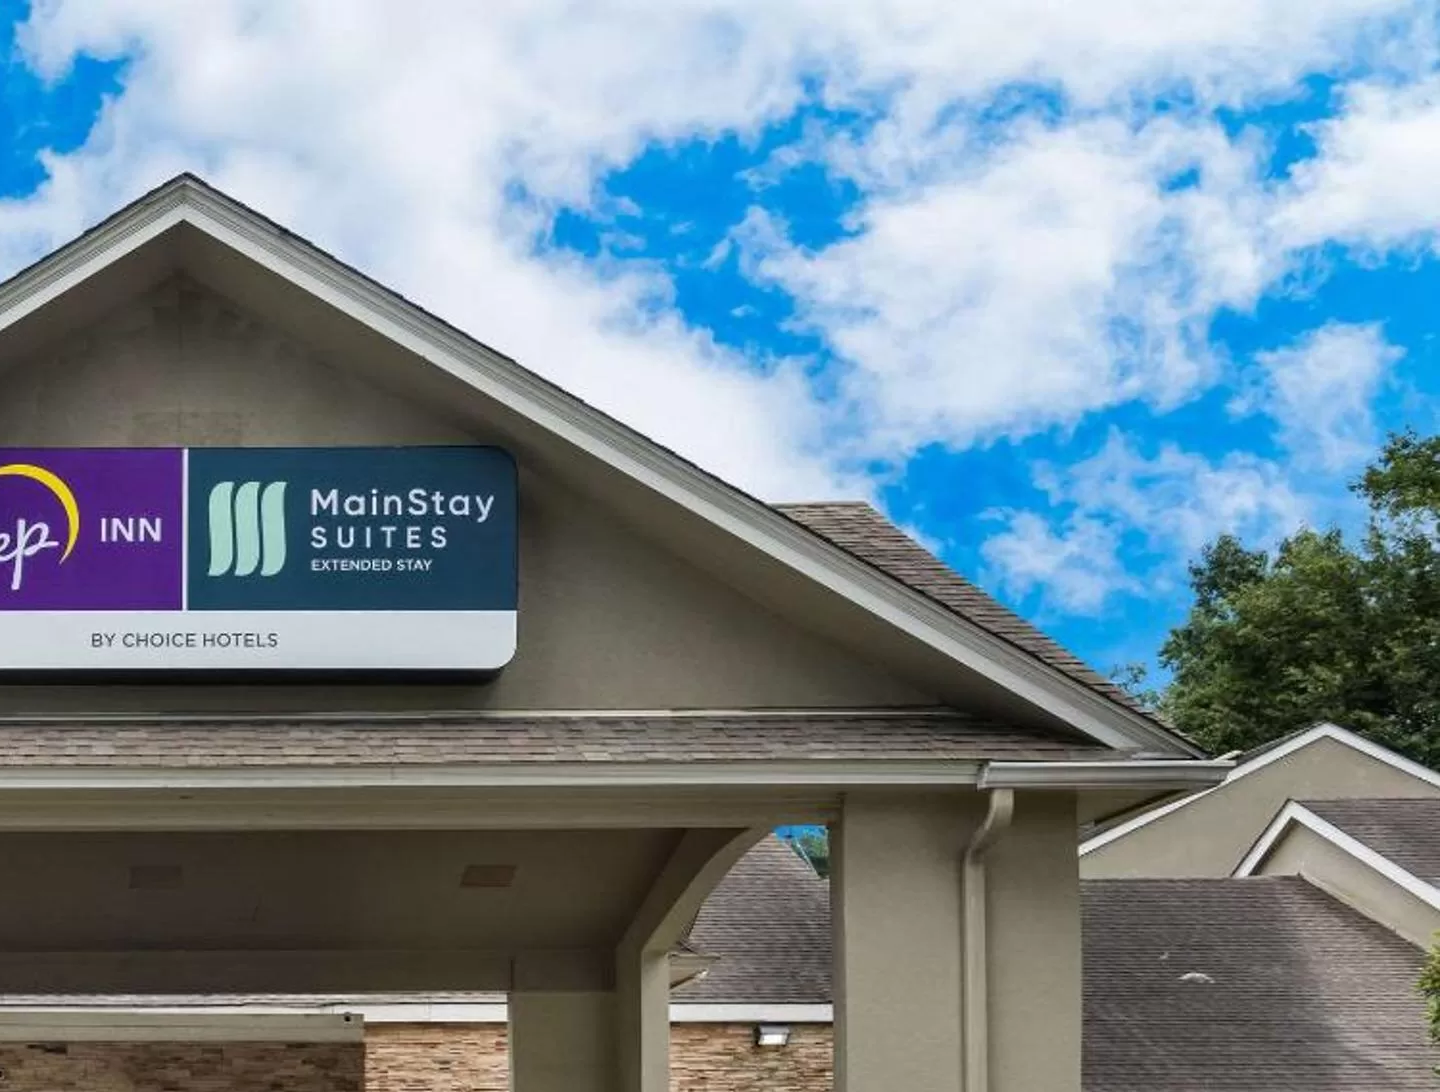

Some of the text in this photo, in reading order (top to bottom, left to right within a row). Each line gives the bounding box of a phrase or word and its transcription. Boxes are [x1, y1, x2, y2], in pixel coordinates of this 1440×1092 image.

[311, 488, 494, 523] MainStay
[101, 517, 162, 543] INN
[310, 526, 447, 549] SUITES
[311, 558, 433, 571] EXTENDED STAY
[91, 632, 278, 648] BY CHOICE HOTELS
